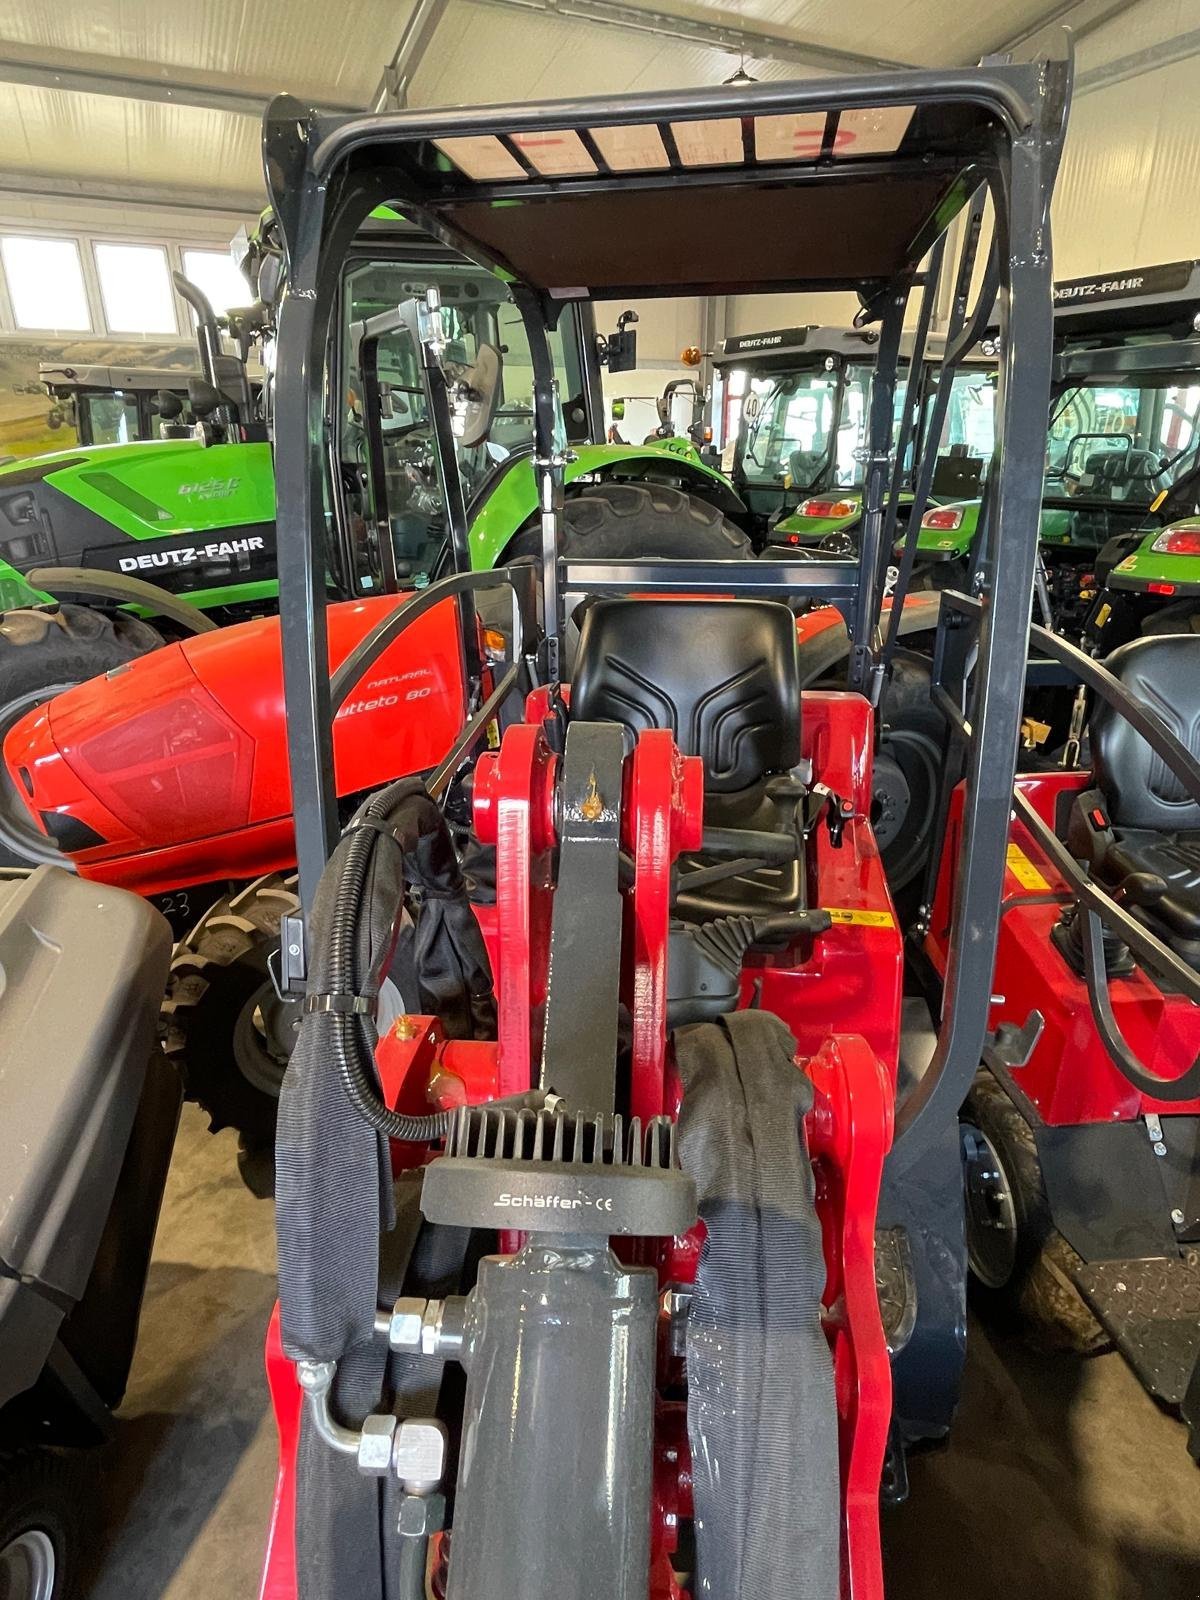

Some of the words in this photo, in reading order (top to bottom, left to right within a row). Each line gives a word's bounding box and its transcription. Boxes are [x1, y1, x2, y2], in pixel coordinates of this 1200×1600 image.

[739, 335, 782, 348] DEUTZ-FAHR
[746, 398, 758, 418] 40
[118, 536, 265, 572] DEUTZ-FAHR
[405, 687, 431, 701] 80
[161, 892, 190, 917] 23
[493, 1193, 582, 1210] Schäffer
